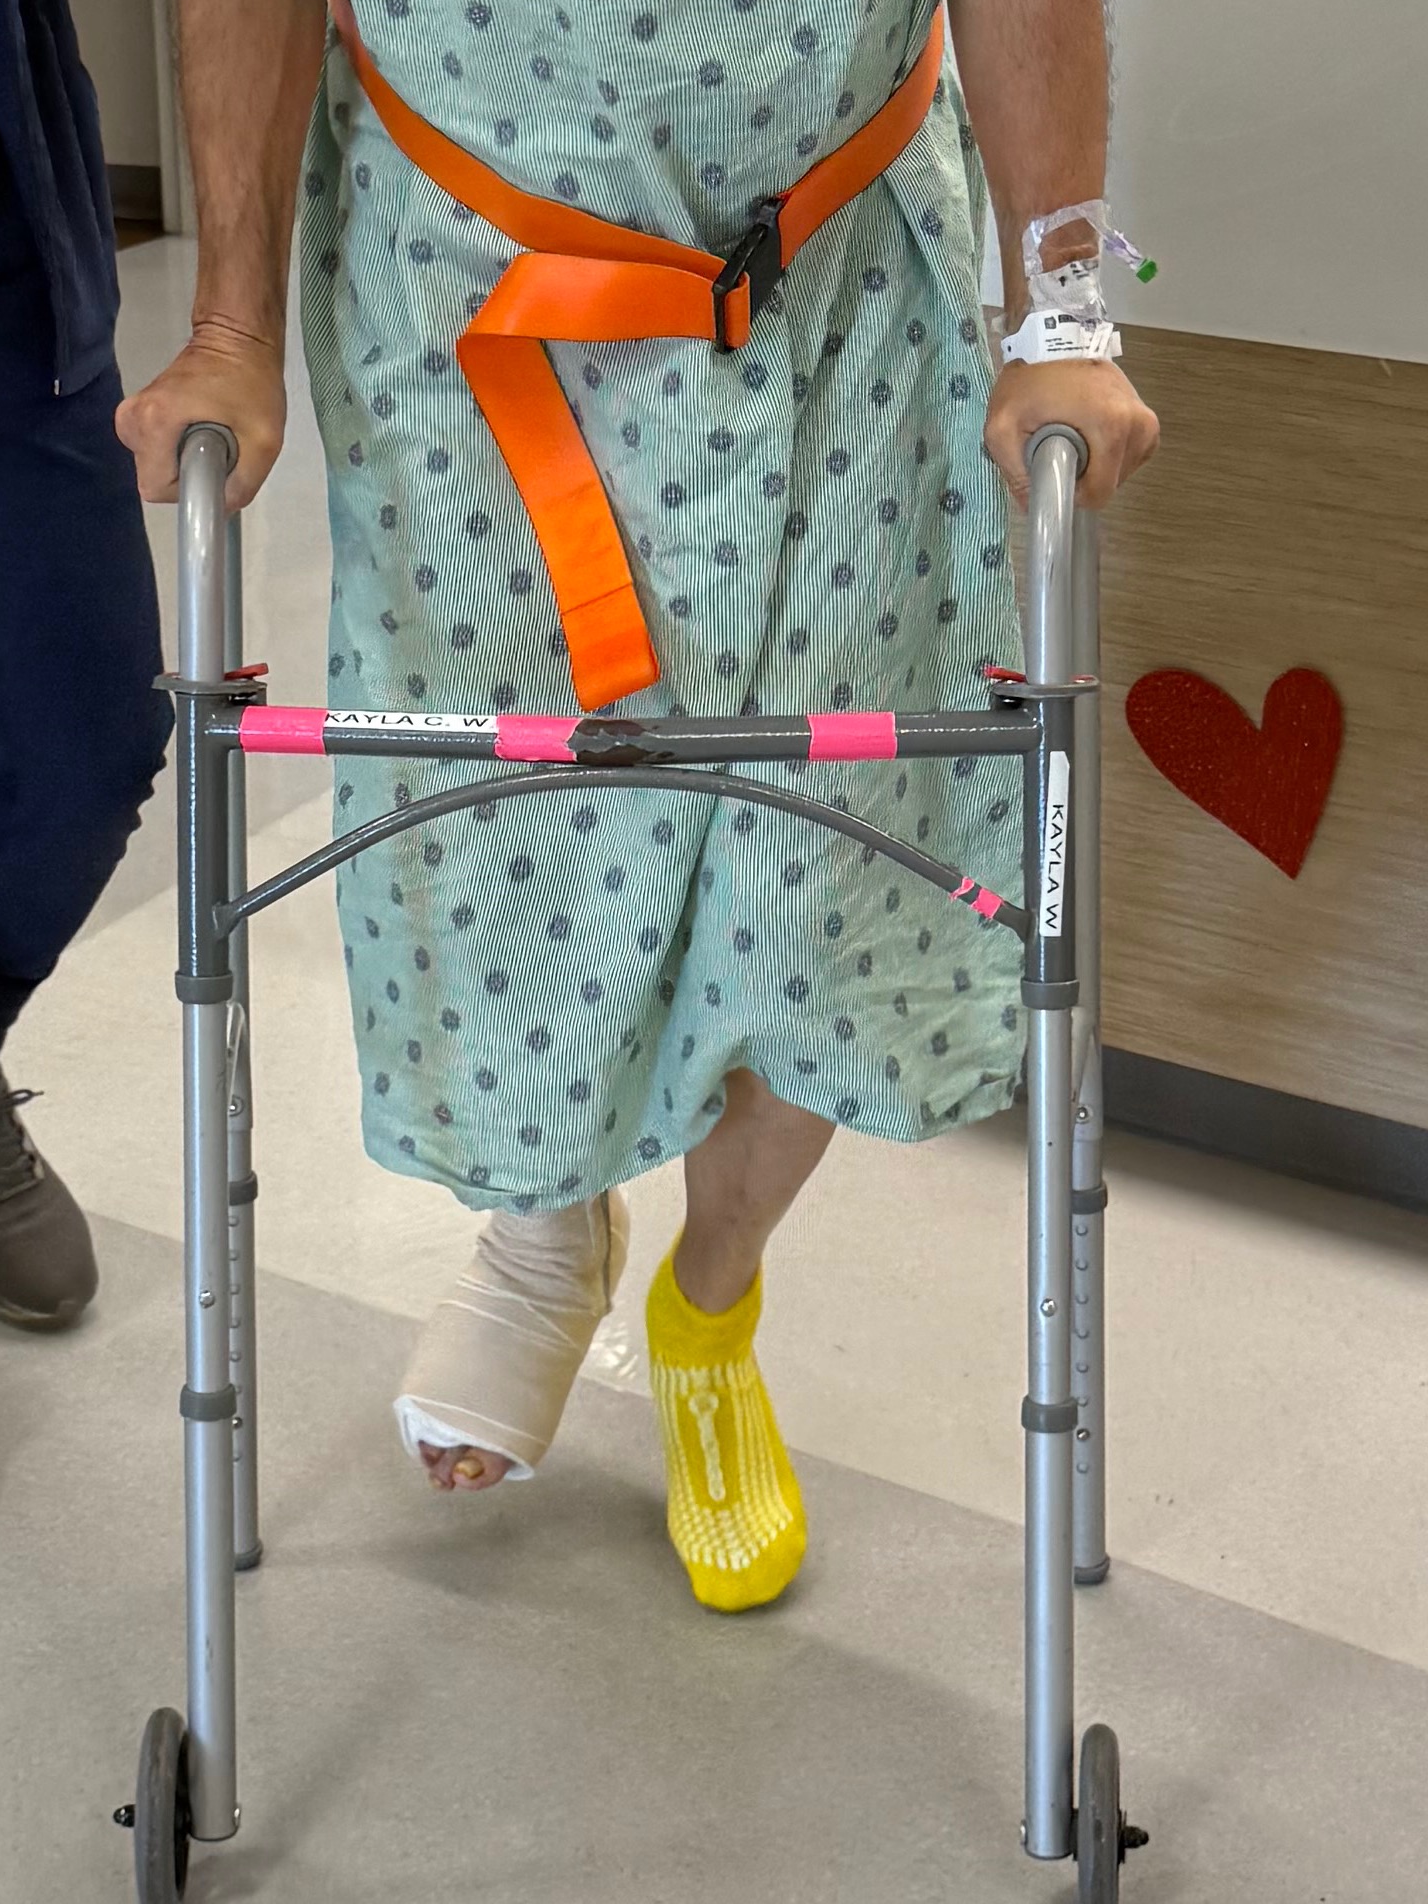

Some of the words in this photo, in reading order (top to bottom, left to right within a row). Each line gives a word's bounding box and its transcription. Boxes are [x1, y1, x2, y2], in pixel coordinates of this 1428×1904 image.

[325, 713, 414, 726] KAYLA
[424, 716, 450, 728] C.
[1047, 804, 1064, 894] KAYLA
[1045, 903, 1060, 929] W
